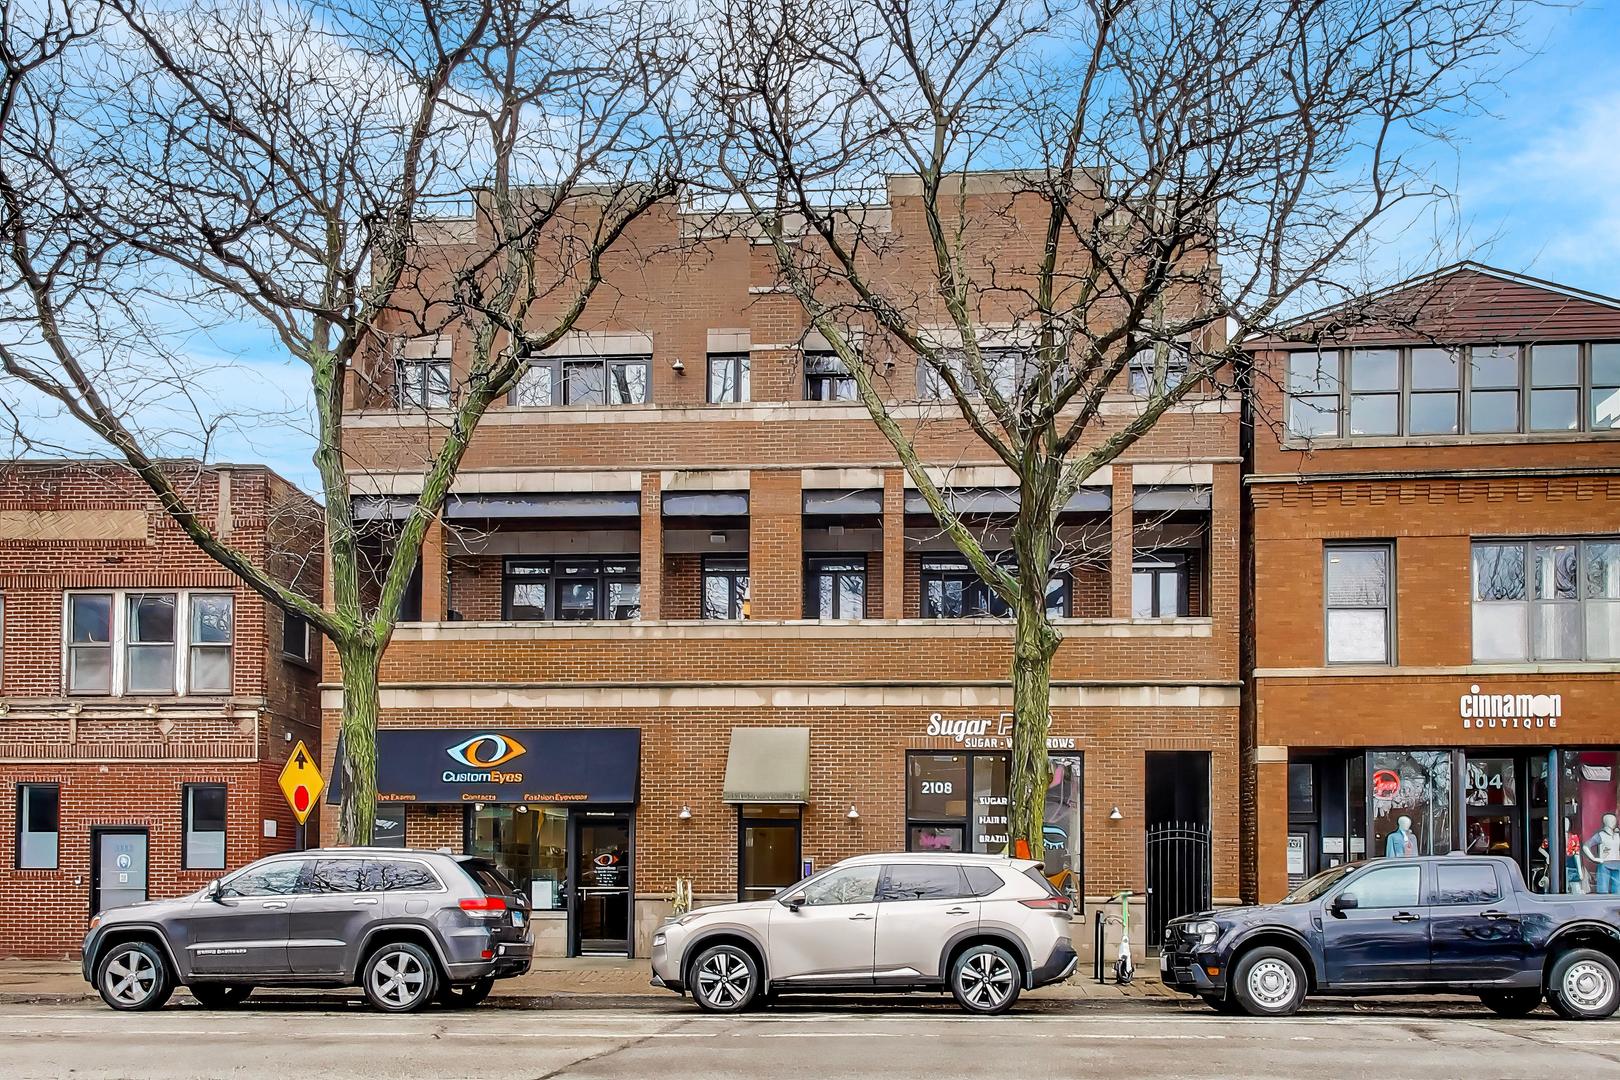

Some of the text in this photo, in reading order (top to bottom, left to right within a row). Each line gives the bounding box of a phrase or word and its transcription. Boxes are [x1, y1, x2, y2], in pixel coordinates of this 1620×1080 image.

[1460, 684, 1562, 718] cinnamon
[926, 713, 992, 742] Sugar
[1463, 718, 1557, 729] BOUTIQUE
[964, 737, 998, 748] SUGAR
[1045, 738, 1075, 748] ROWS
[442, 770, 523, 784] CustomEyes
[921, 781, 952, 794] 2108
[461, 793, 497, 801] Contacts
[979, 796, 1008, 805] SUGAR
